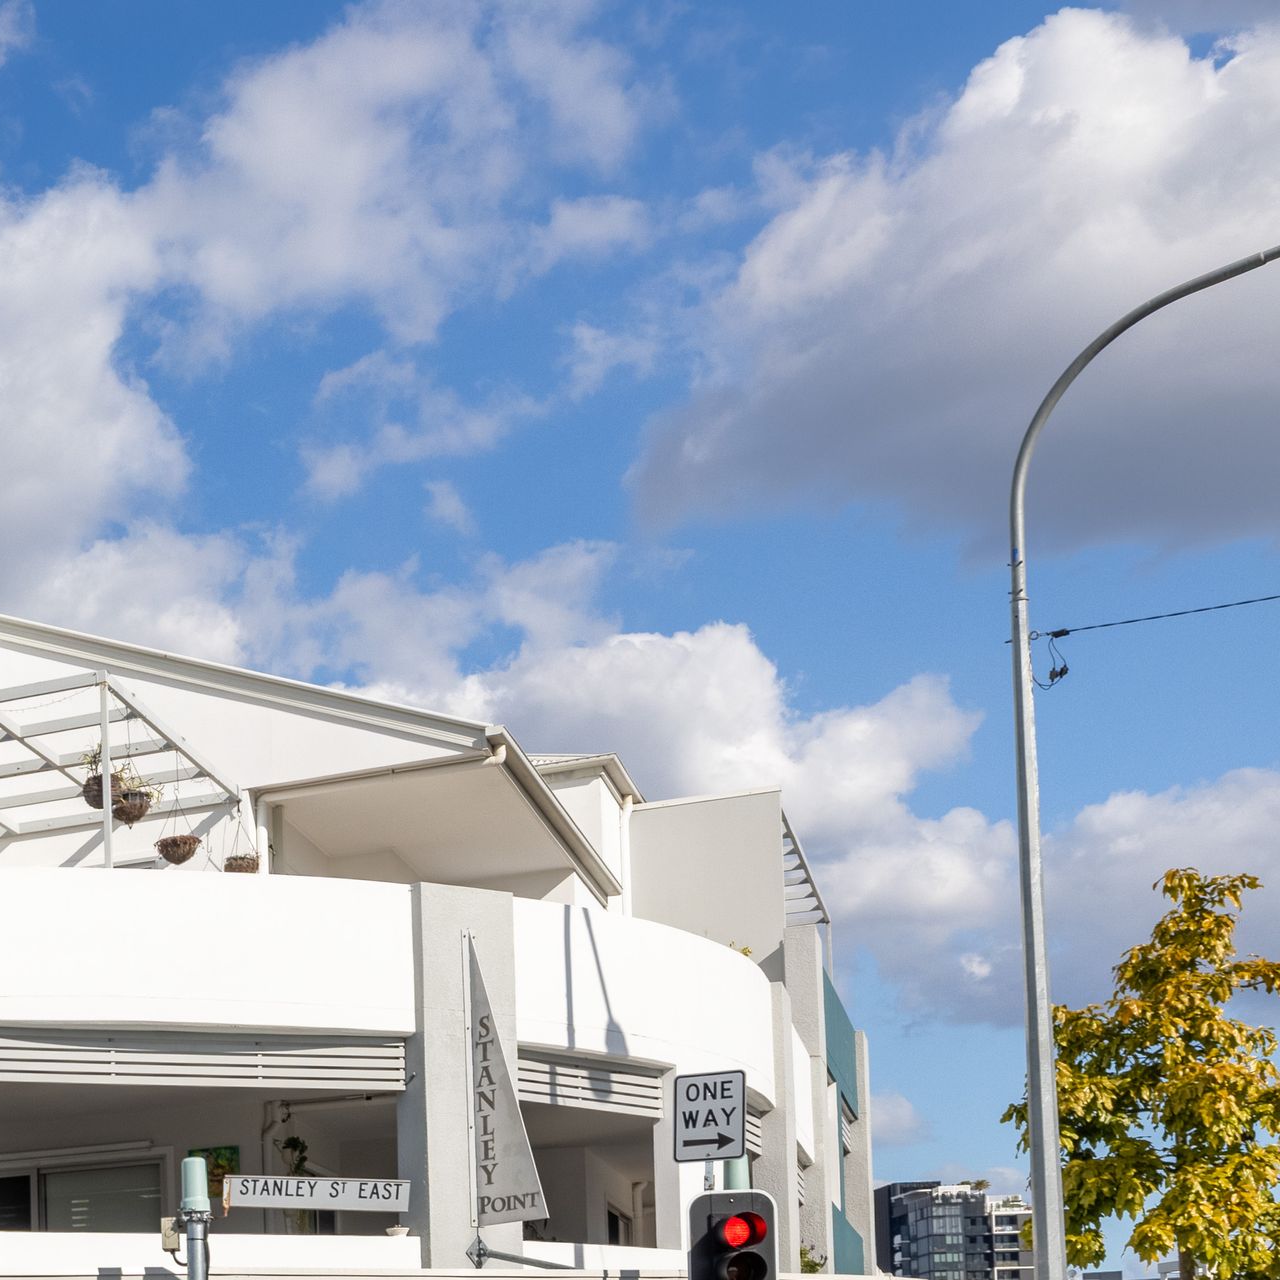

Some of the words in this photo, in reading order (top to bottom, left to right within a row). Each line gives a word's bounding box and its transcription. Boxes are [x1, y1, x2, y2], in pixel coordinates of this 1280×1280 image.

[475, 1013, 499, 1186] STANLEY
[686, 1080, 733, 1102] ONE
[682, 1107, 736, 1129] WAY
[239, 1178, 318, 1198] STANLEY
[328, 1181, 348, 1199] ST
[357, 1182, 403, 1201] EAST
[479, 1192, 539, 1215] POINT
